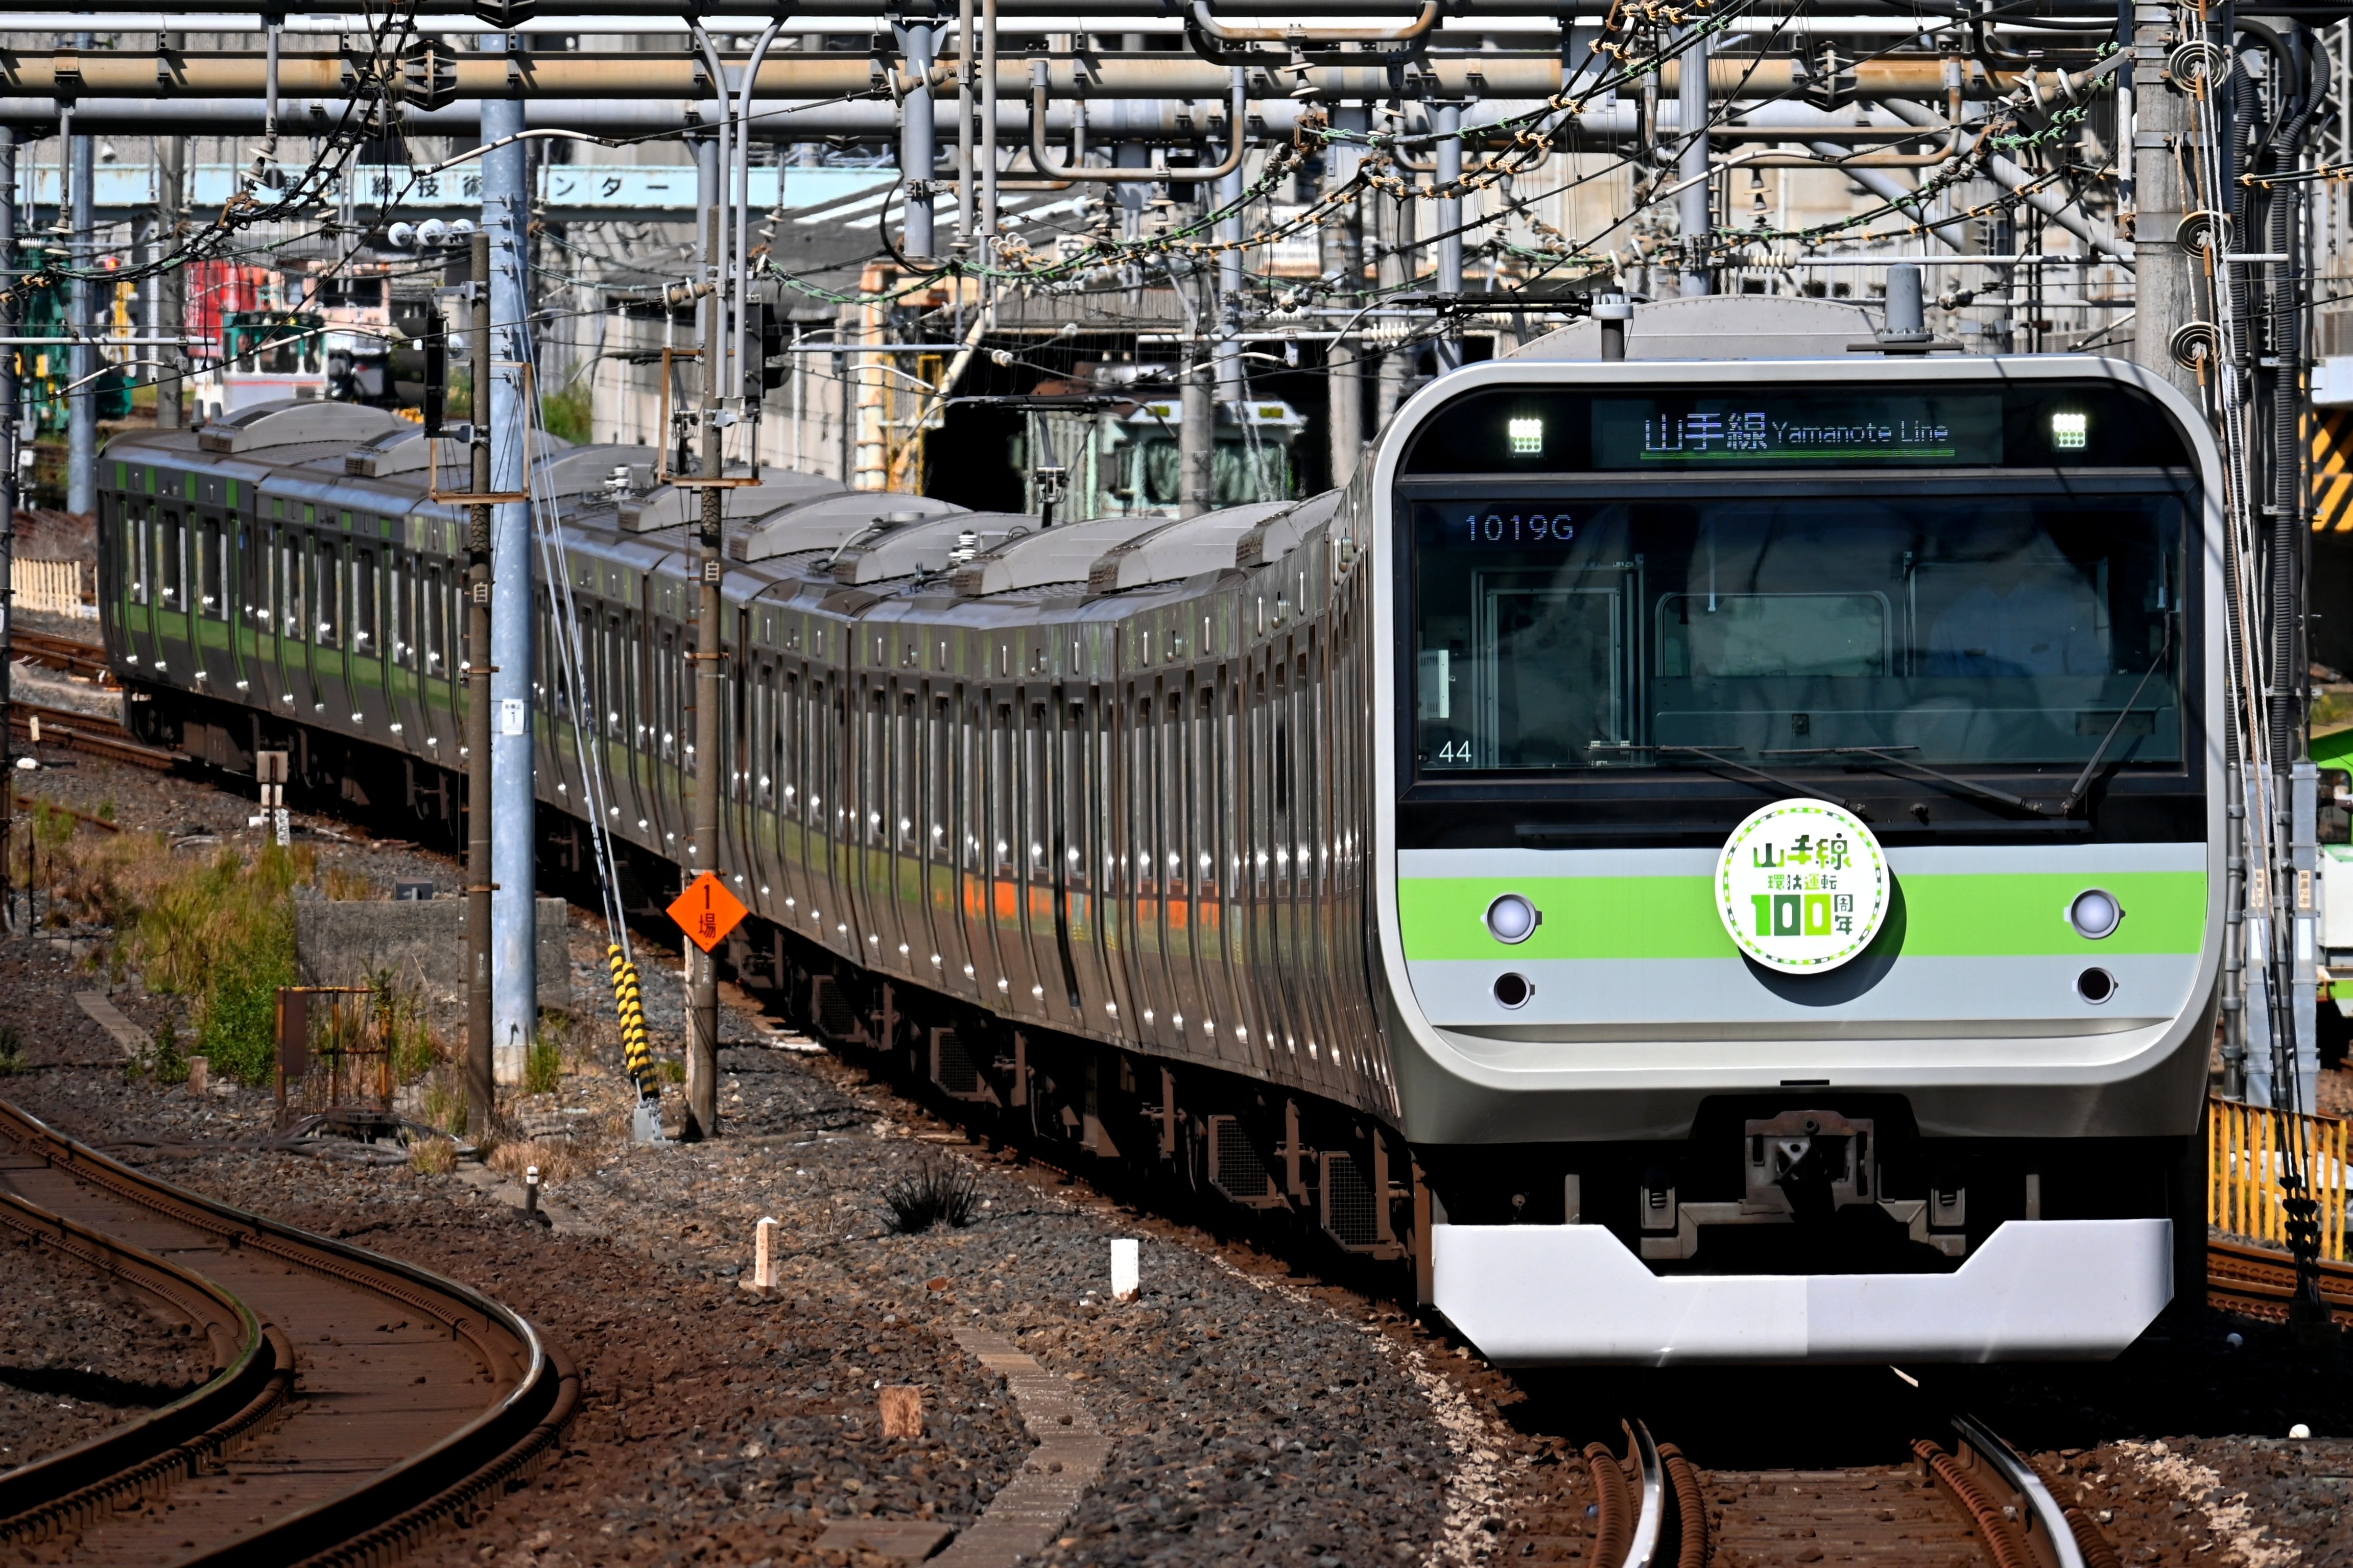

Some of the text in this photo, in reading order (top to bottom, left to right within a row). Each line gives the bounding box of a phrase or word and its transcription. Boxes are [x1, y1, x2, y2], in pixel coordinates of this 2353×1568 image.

[1645, 413, 1948, 451] 山手線 Yamanote Line
[1466, 514, 1574, 541] 1019G
[705, 560, 720, 582] 自
[473, 582, 488, 603] 自
[1439, 740, 1472, 763] 44
[1753, 832, 1852, 871] 山手線
[1767, 874, 1837, 890] 環状運転
